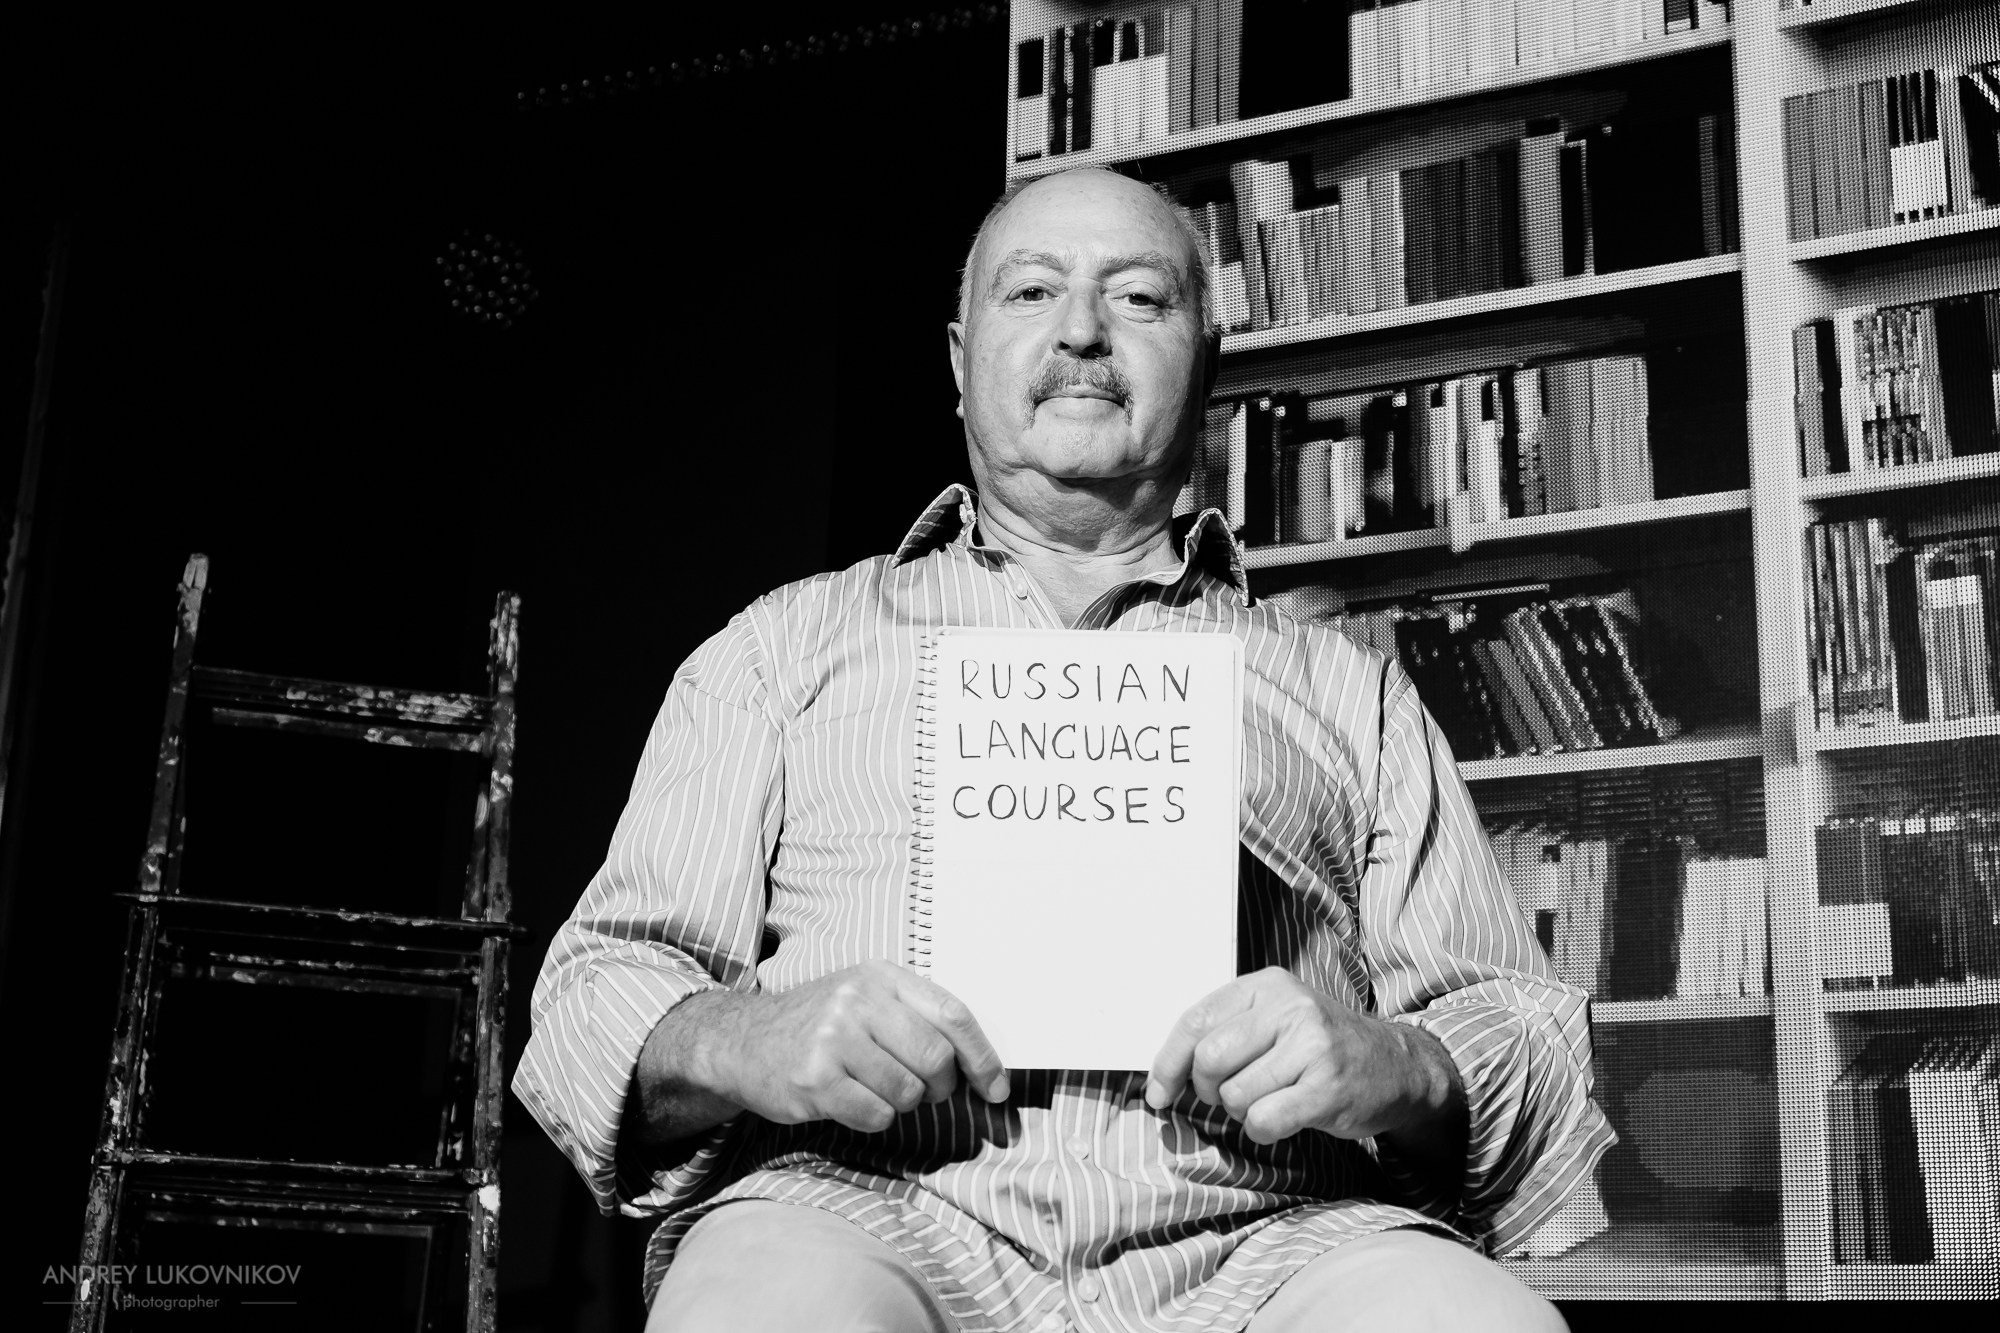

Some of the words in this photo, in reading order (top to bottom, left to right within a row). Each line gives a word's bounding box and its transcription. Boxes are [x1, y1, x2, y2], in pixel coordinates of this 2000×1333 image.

[961, 659, 1190, 704] RUSSIAN
[958, 719, 1191, 763] LANGUAGE
[952, 783, 1185, 823] COURSES
